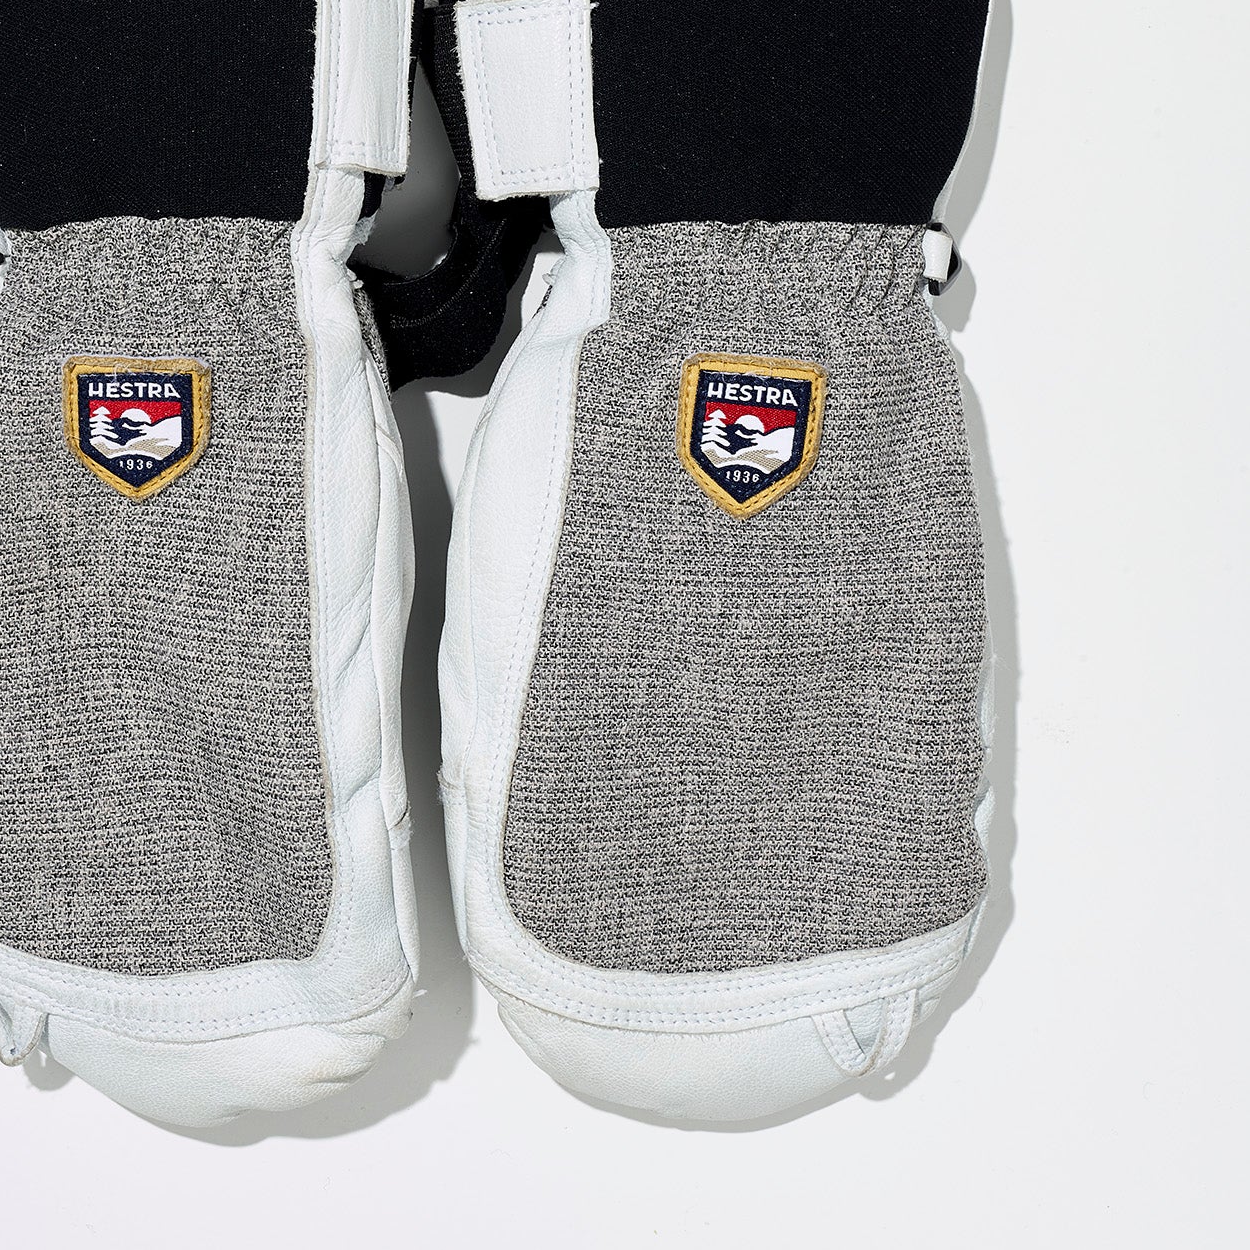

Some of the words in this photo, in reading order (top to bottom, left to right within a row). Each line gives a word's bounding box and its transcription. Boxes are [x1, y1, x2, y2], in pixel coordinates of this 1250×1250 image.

[88, 382, 181, 398] HESTRA
[707, 382, 798, 407] HESTRA
[118, 459, 153, 471] 1936
[725, 470, 760, 484] 1936
